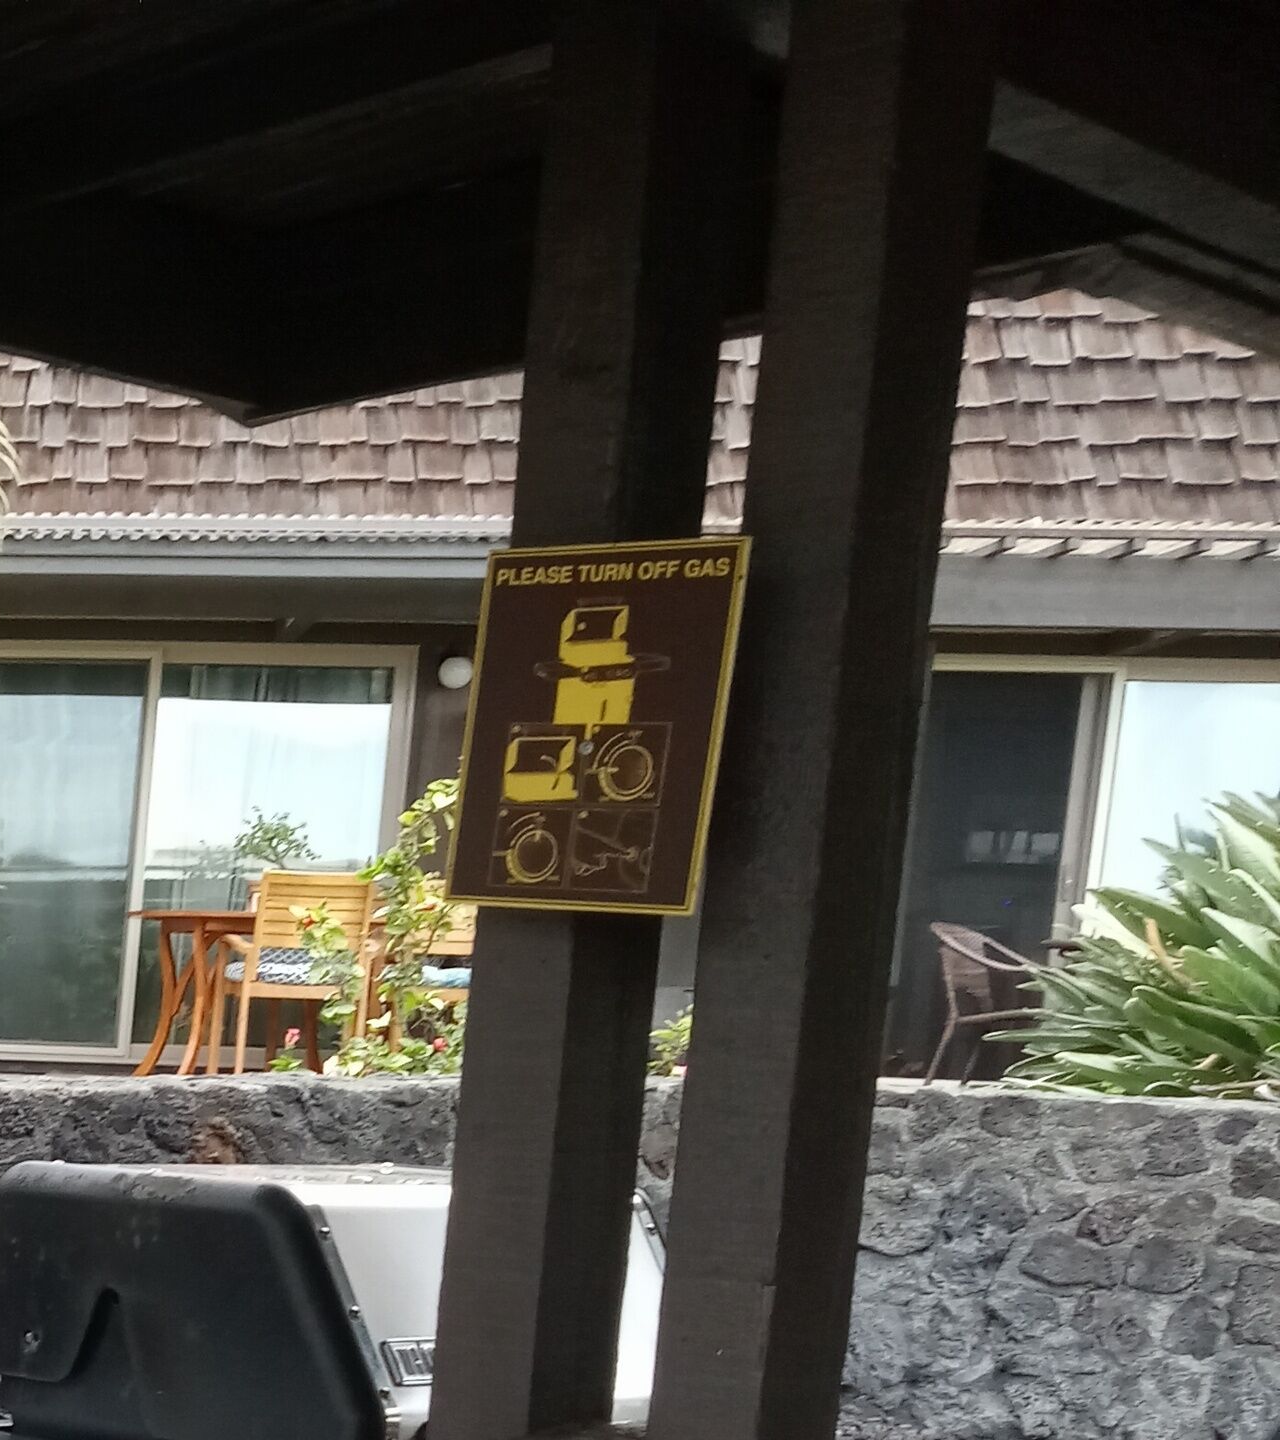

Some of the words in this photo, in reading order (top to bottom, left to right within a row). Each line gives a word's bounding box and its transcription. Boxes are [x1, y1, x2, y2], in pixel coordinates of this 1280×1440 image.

[496, 565, 573, 587] PLEASE
[578, 562, 633, 583] TURN
[637, 559, 681, 580] OFF
[683, 557, 731, 578] GAS
